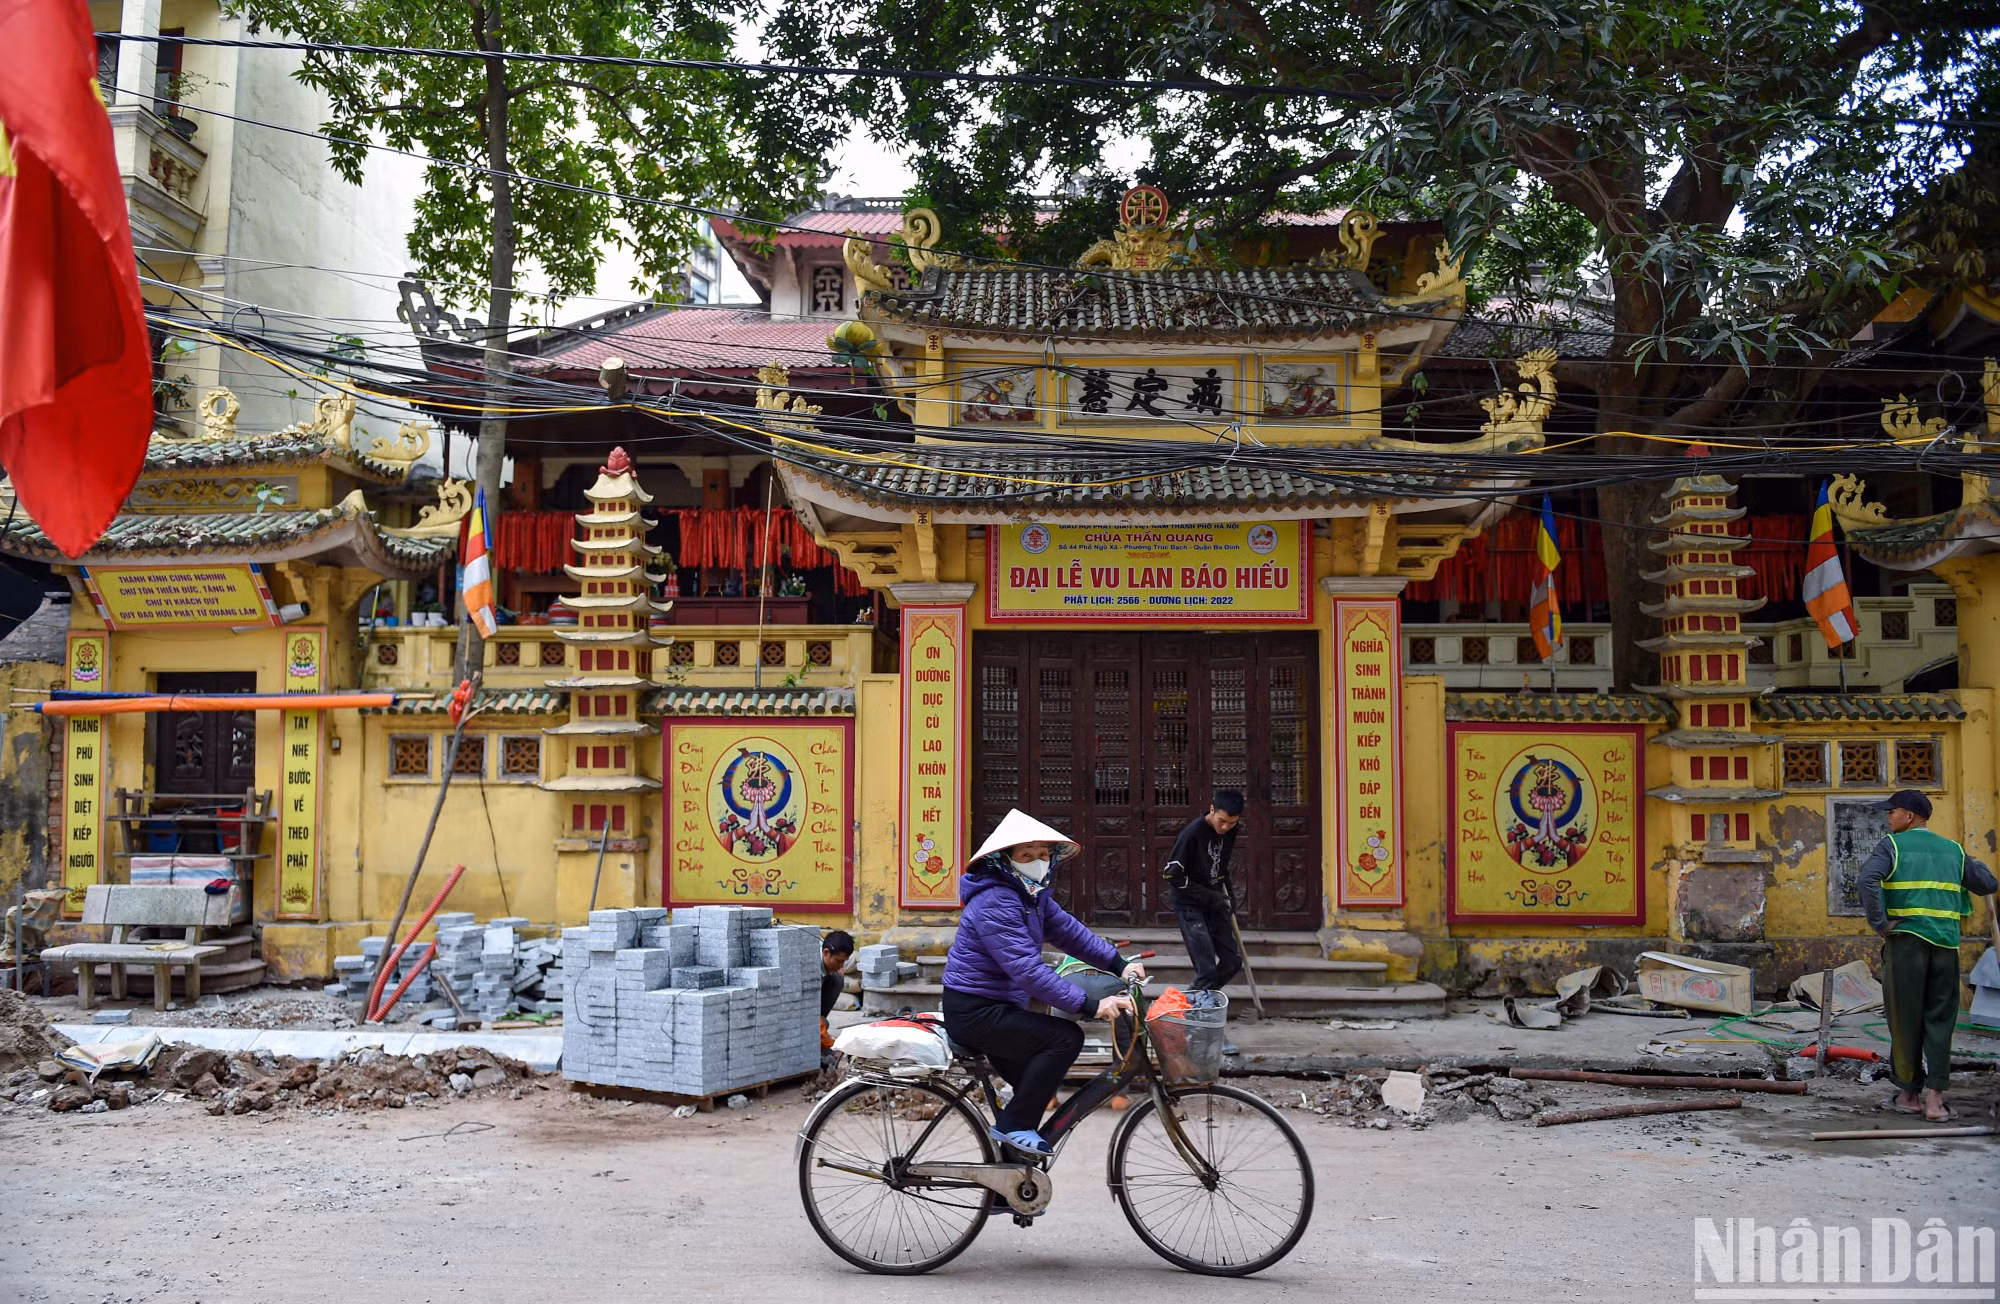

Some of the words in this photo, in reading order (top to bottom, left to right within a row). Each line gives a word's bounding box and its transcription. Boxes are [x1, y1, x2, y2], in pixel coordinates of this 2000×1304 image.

[1084, 531, 1121, 542] CHÙA
[1165, 533, 1214, 542] QUANG
[169, 574, 192, 582] CUNG
[194, 573, 227, 581] NGHINH
[1010, 567, 1049, 592] ĐẠI
[1056, 558, 1082, 588] LỄ
[1090, 567, 1120, 588] VU
[1127, 567, 1173, 588] LAN
[1181, 563, 1228, 588] BÁO
[1235, 559, 1289, 588] HIẾU
[226, 584, 236, 592] NI
[1064, 595, 1088, 606] PHẬT
[1091, 596, 1115, 607] LỊCH:
[1117, 596, 1140, 604] 2566
[1149, 595, 1182, 605] DƯƠNG
[1184, 596, 1208, 606] LỊCH:
[1211, 596, 1234, 605] 2022
[209, 608, 237, 616] QUANG
[926, 645, 941, 659] ƠN
[1351, 638, 1384, 653] NGHĨA
[915, 666, 951, 682] DƯỠNG
[1355, 663, 1380, 676] SINH
[1351, 684, 1386, 700] THÀNH
[922, 693, 943, 708] DỤC
[294, 715, 309, 730] TAY
[926, 713, 940, 728] CÙ
[1353, 708, 1385, 724] MUÔN
[922, 739, 942, 752] LAO
[1357, 730, 1381, 747] KIẾP
[76, 744, 93, 760] PHÙ
[292, 744, 309, 760] NHẸ
[918, 760, 946, 775] KHÔN
[1359, 756, 1380, 771] KHÓ
[74, 773, 93, 786] SINH
[288, 768, 311, 784] BƯỚC
[922, 781, 942, 798] TRẢ
[1359, 779, 1381, 795] ĐÁP
[74, 798, 92, 816] DIỆT
[922, 805, 942, 822] HẾT
[73, 823, 91, 841] KIẾP
[288, 826, 309, 840] THEO
[69, 851, 94, 868] NGƯỜI
[287, 852, 308, 871] PHẬT
